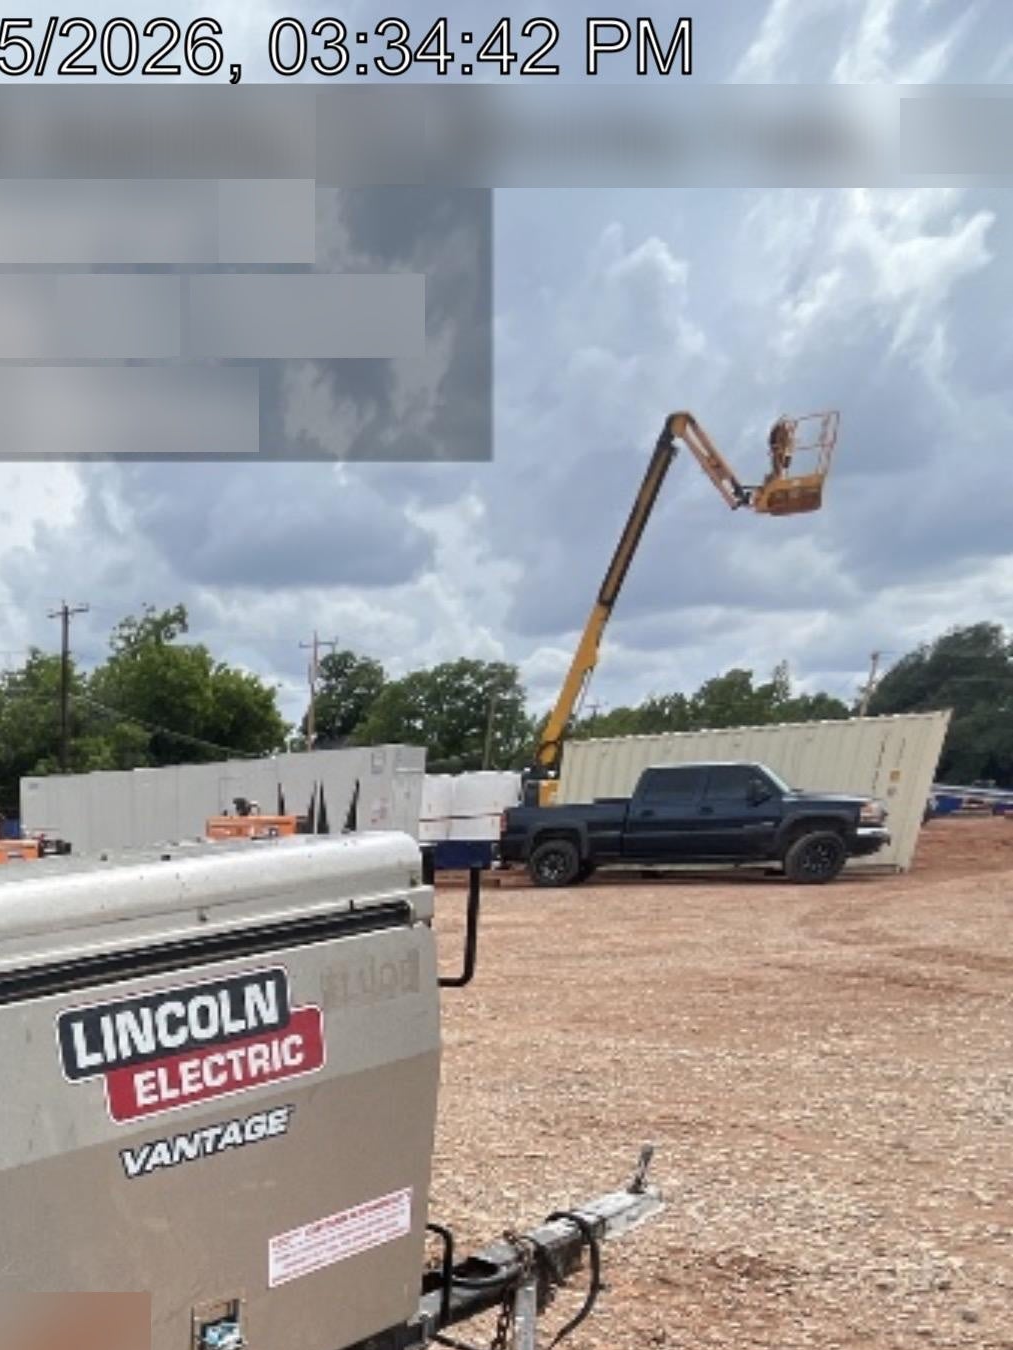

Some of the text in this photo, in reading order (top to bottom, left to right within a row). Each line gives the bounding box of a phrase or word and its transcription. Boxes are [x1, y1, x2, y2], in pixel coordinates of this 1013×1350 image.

[71, 980, 279, 1069] LINCOLN
[133, 1034, 304, 1107] ELECTRIC
[120, 1107, 291, 1178] VANTAGE
